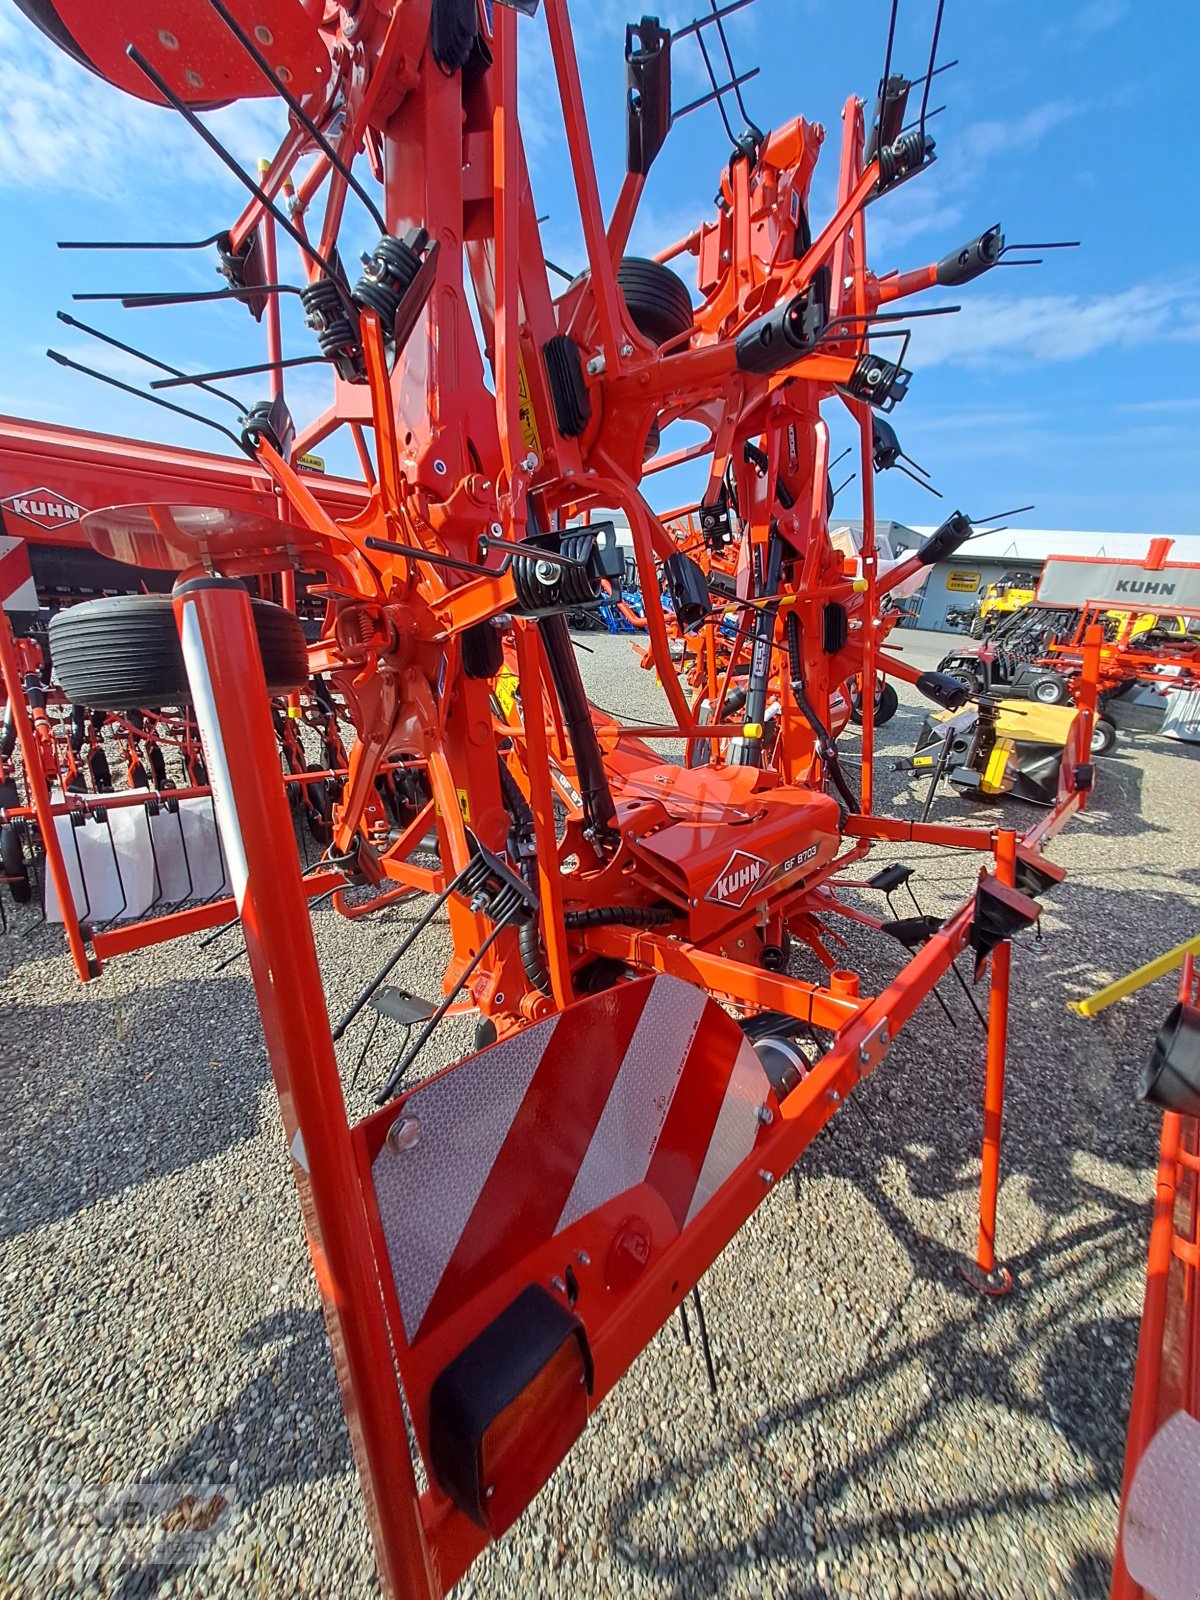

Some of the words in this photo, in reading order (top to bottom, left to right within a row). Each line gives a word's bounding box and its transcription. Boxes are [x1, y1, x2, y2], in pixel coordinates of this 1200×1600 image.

[13, 499, 80, 519] KUHN
[1115, 580, 1177, 595] KUHN
[570, 790, 584, 807] 87
[784, 858, 796, 871] GF
[797, 845, 817, 864] 8703
[717, 861, 760, 899] KUHN
